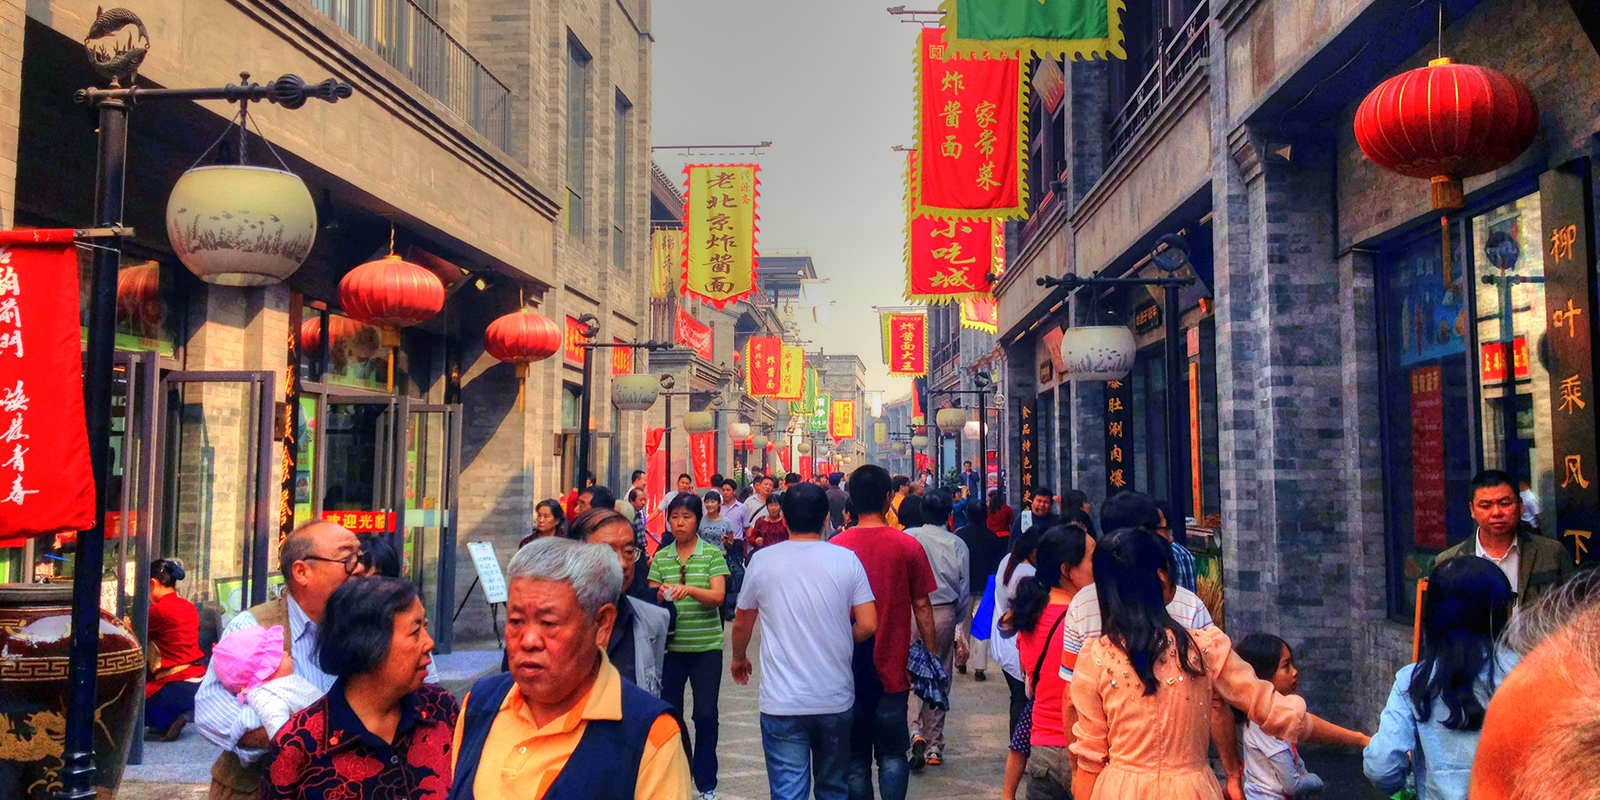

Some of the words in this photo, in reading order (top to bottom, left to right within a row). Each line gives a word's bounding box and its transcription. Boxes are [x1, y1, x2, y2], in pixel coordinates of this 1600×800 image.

[939, 70, 965, 159] 炸酱面
[975, 100, 1001, 191] 家常菜
[702, 172, 738, 294] 老北京炸酱面
[928, 220, 976, 289] 小吃城
[1551, 223, 1592, 564] 柳叶乘风下
